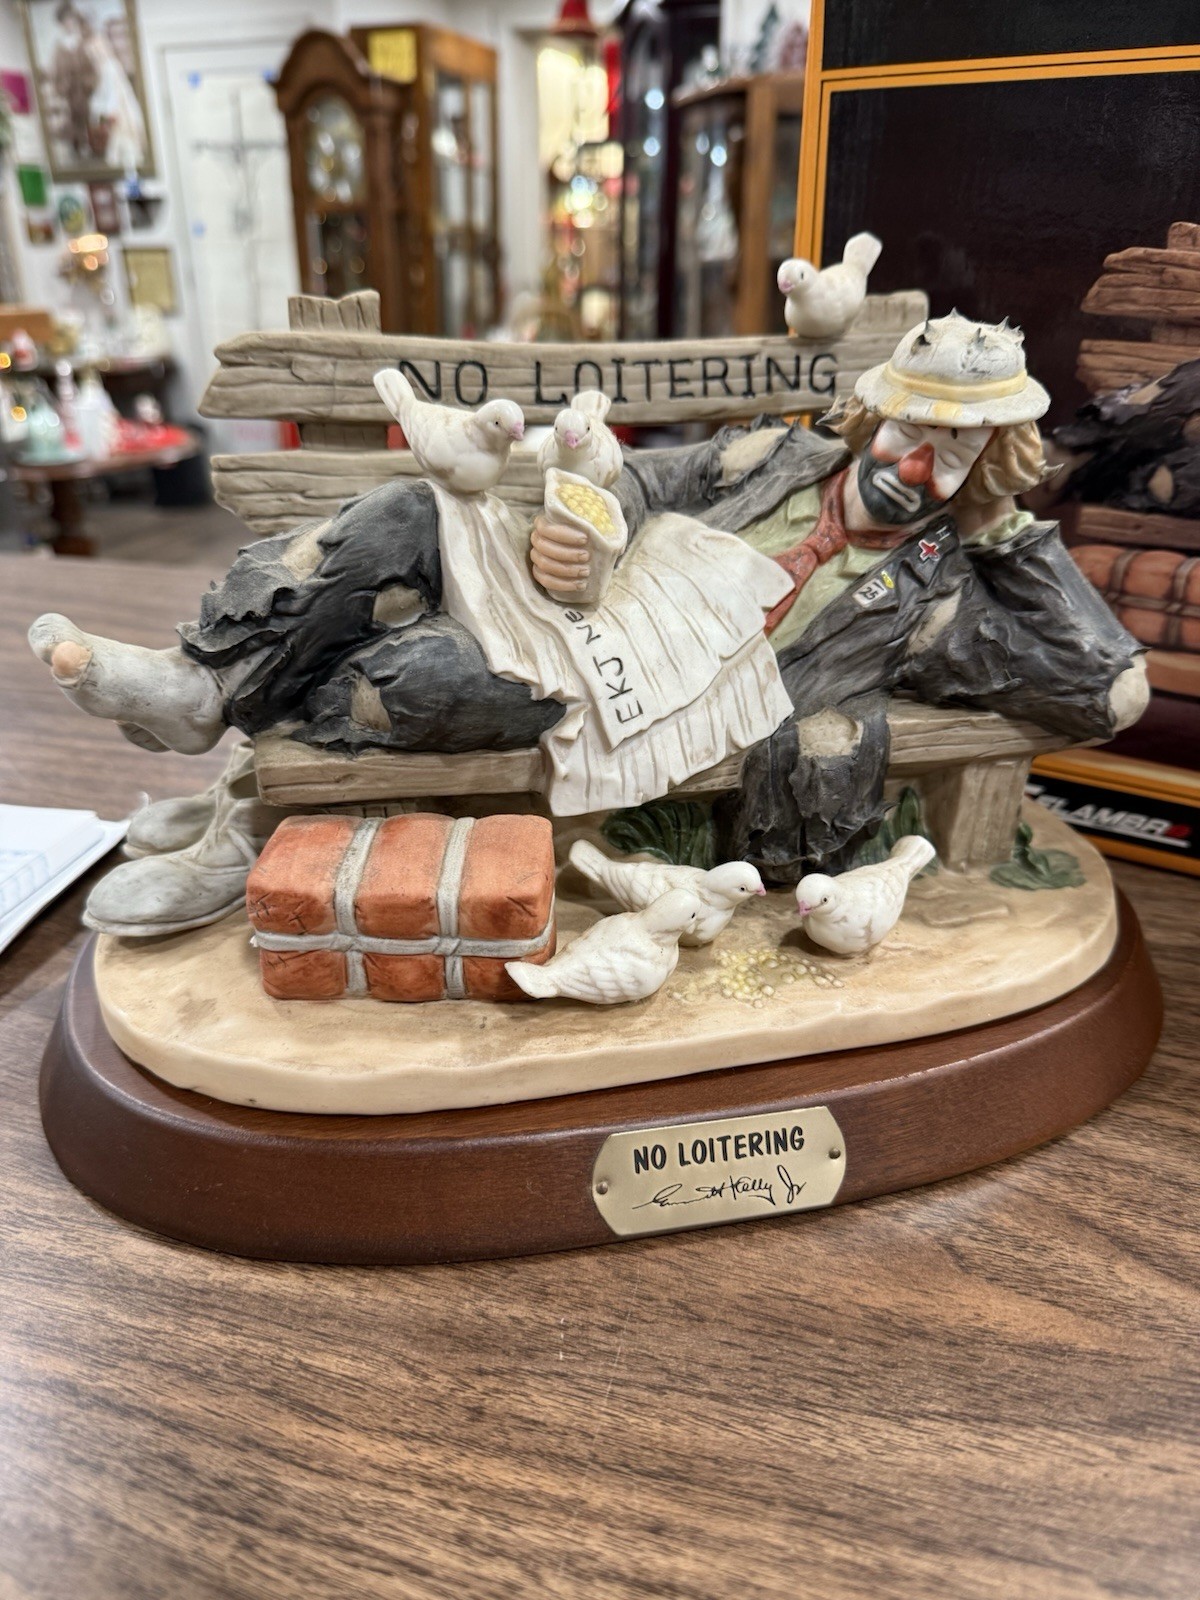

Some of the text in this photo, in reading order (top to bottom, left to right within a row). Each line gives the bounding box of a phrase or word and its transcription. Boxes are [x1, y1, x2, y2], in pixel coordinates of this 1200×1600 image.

[399, 352, 838, 406] NO LOITERING
[593, 656, 643, 724] EKJ
[633, 1126, 805, 1174] NO LOITERING
[728, 1175, 776, 1206] Kelly
